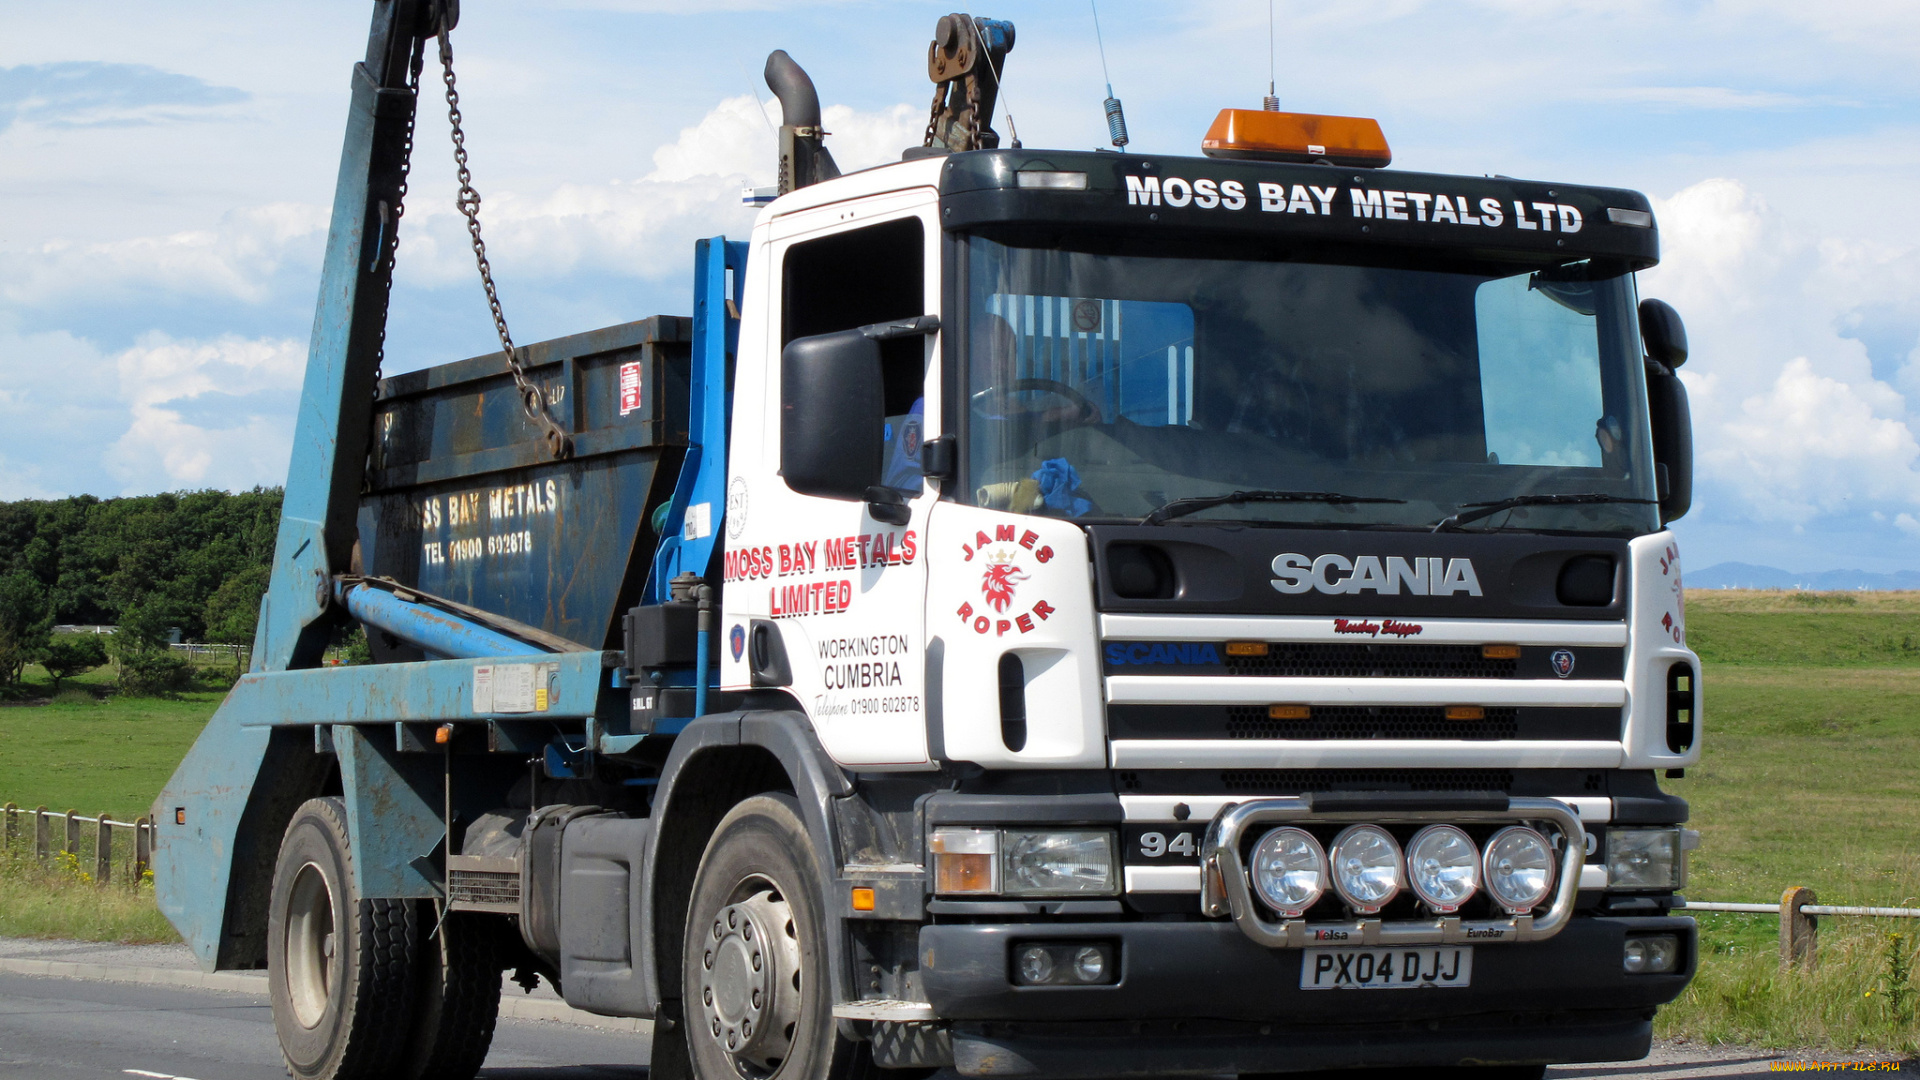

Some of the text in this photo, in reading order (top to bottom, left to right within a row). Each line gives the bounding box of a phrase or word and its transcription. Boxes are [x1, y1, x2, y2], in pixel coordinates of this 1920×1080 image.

[1125, 175, 1583, 234] MOSS BAY METALS LTD
[448, 492, 480, 525] BAY
[489, 479, 556, 519] METALS
[424, 530, 532, 564] TEL 01900 602878
[723, 530, 917, 582] MOSS BAY METALS
[962, 524, 1055, 564] JAMES
[1270, 552, 1484, 597] SCANIA
[770, 580, 852, 619] LIMITED
[956, 599, 1056, 637] ROPER
[818, 634, 908, 659] WORKINGTON
[1105, 642, 1220, 666] SCANIA
[824, 661, 902, 690] CUMBRIA
[814, 694, 920, 725] Telephone 01900 602878
[1140, 831, 1200, 857] 94
[1466, 927, 1505, 939] EuroBar
[1313, 950, 1461, 985] PX04 DJJ
